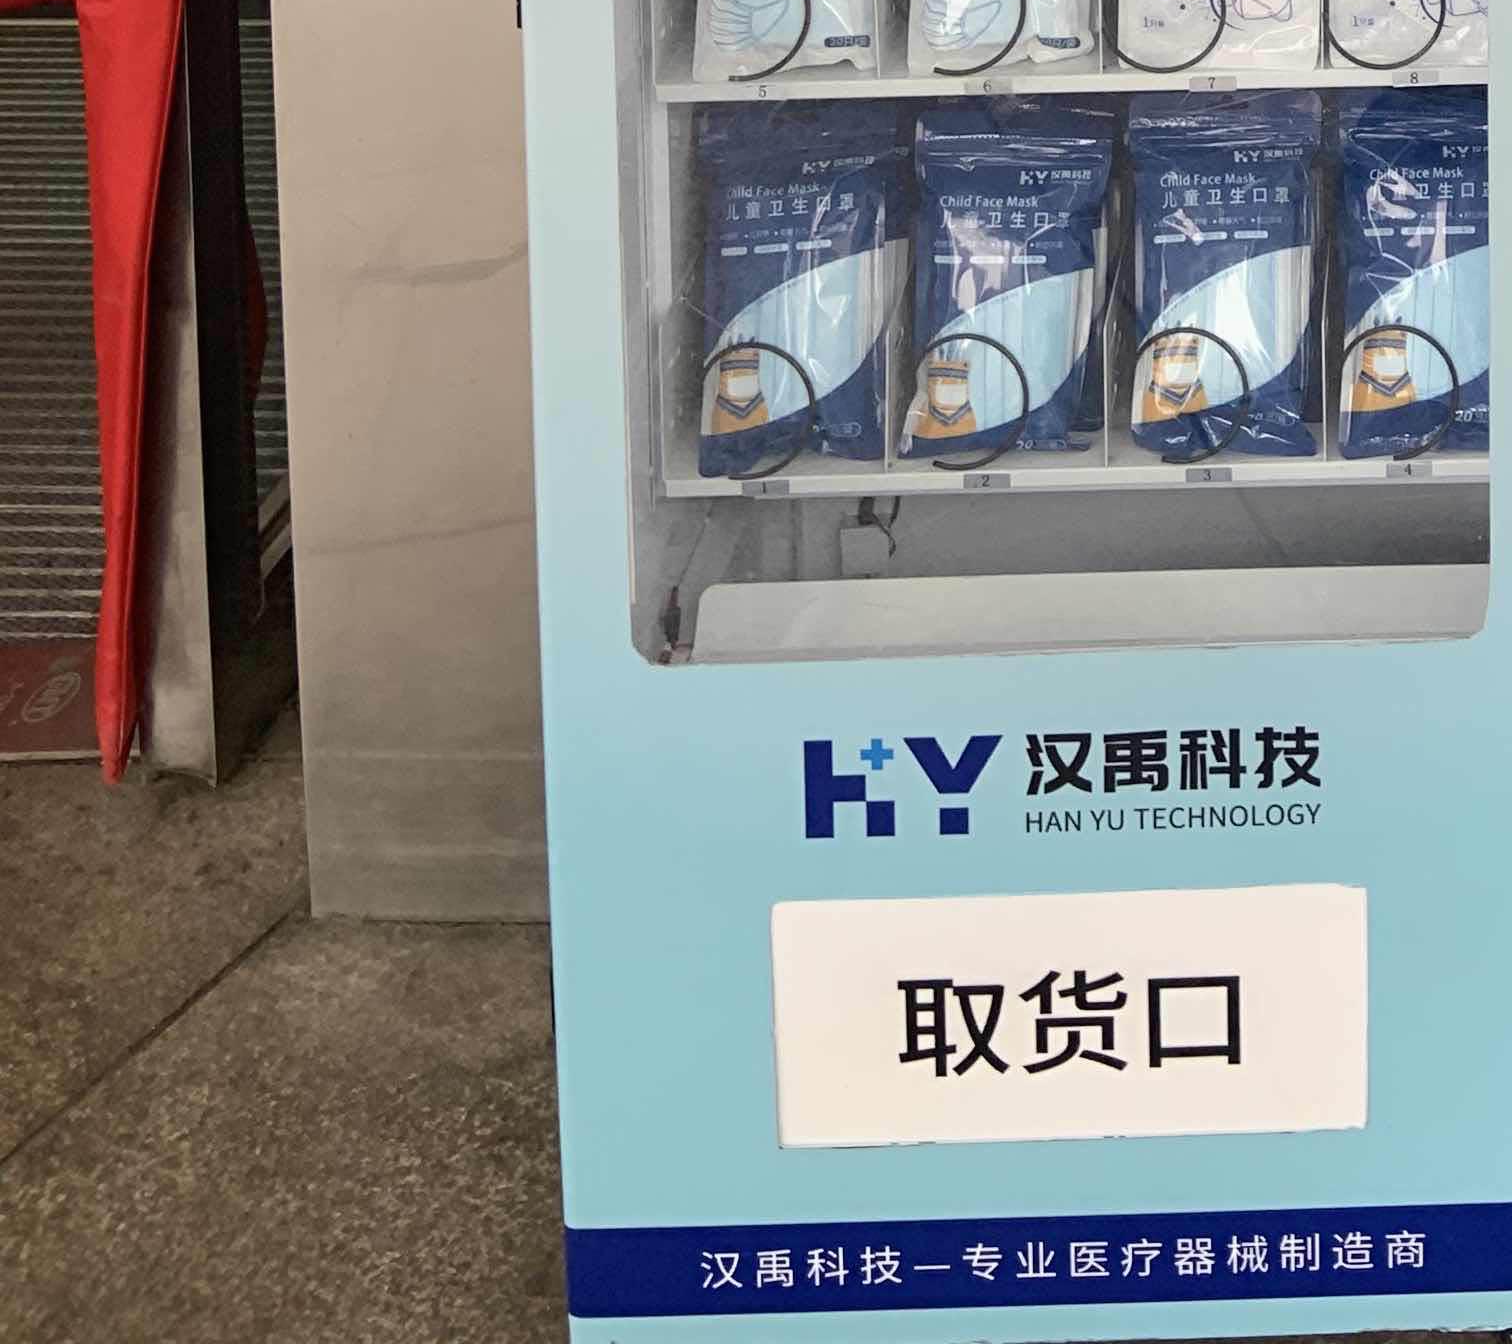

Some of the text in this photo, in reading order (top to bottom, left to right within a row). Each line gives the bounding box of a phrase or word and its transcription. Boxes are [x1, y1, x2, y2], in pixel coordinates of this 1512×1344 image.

[1194, 173, 1222, 185] Face
[1224, 172, 1257, 184] Mask
[1401, 167, 1429, 179] Face
[1432, 166, 1464, 179] Mask
[756, 184, 784, 197] Face
[788, 182, 820, 195] Mask
[1162, 186, 1290, 209] 儿童卫生口罩
[939, 194, 1039, 208] Child Face Mask
[1025, 725, 1322, 796] 汉禹科技
[1025, 802, 1322, 833] HAN YU TECHNOLOGY
[897, 969, 1243, 1079] 取货口
